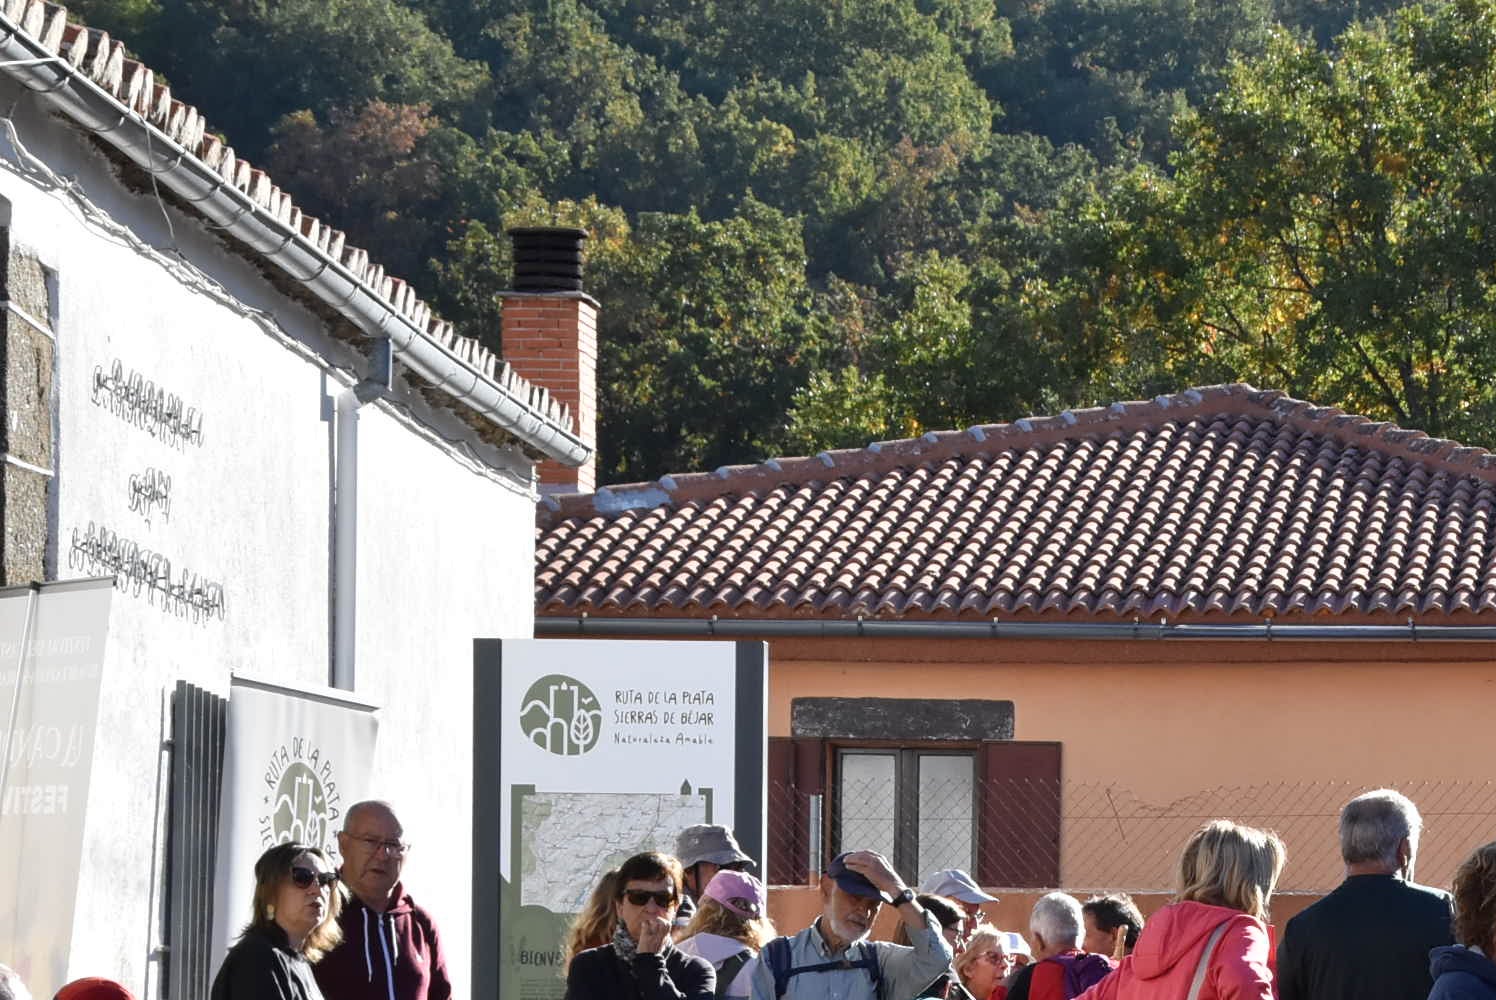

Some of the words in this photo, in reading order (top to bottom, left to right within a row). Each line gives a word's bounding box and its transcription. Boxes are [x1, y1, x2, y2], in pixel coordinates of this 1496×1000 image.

[615, 690, 642, 705] RUTA
[648, 691, 660, 705] DE
[664, 691, 677, 705] LA
[682, 690, 714, 705] PLATA
[614, 709, 658, 724] SIERRAS
[663, 711, 676, 724] DE
[675, 732, 713, 744] Amable
[264, 745, 290, 790] RUTA
[293, 737, 303, 759] DE
[307, 741, 320, 769] LA
[320, 760, 341, 821] PLATA
